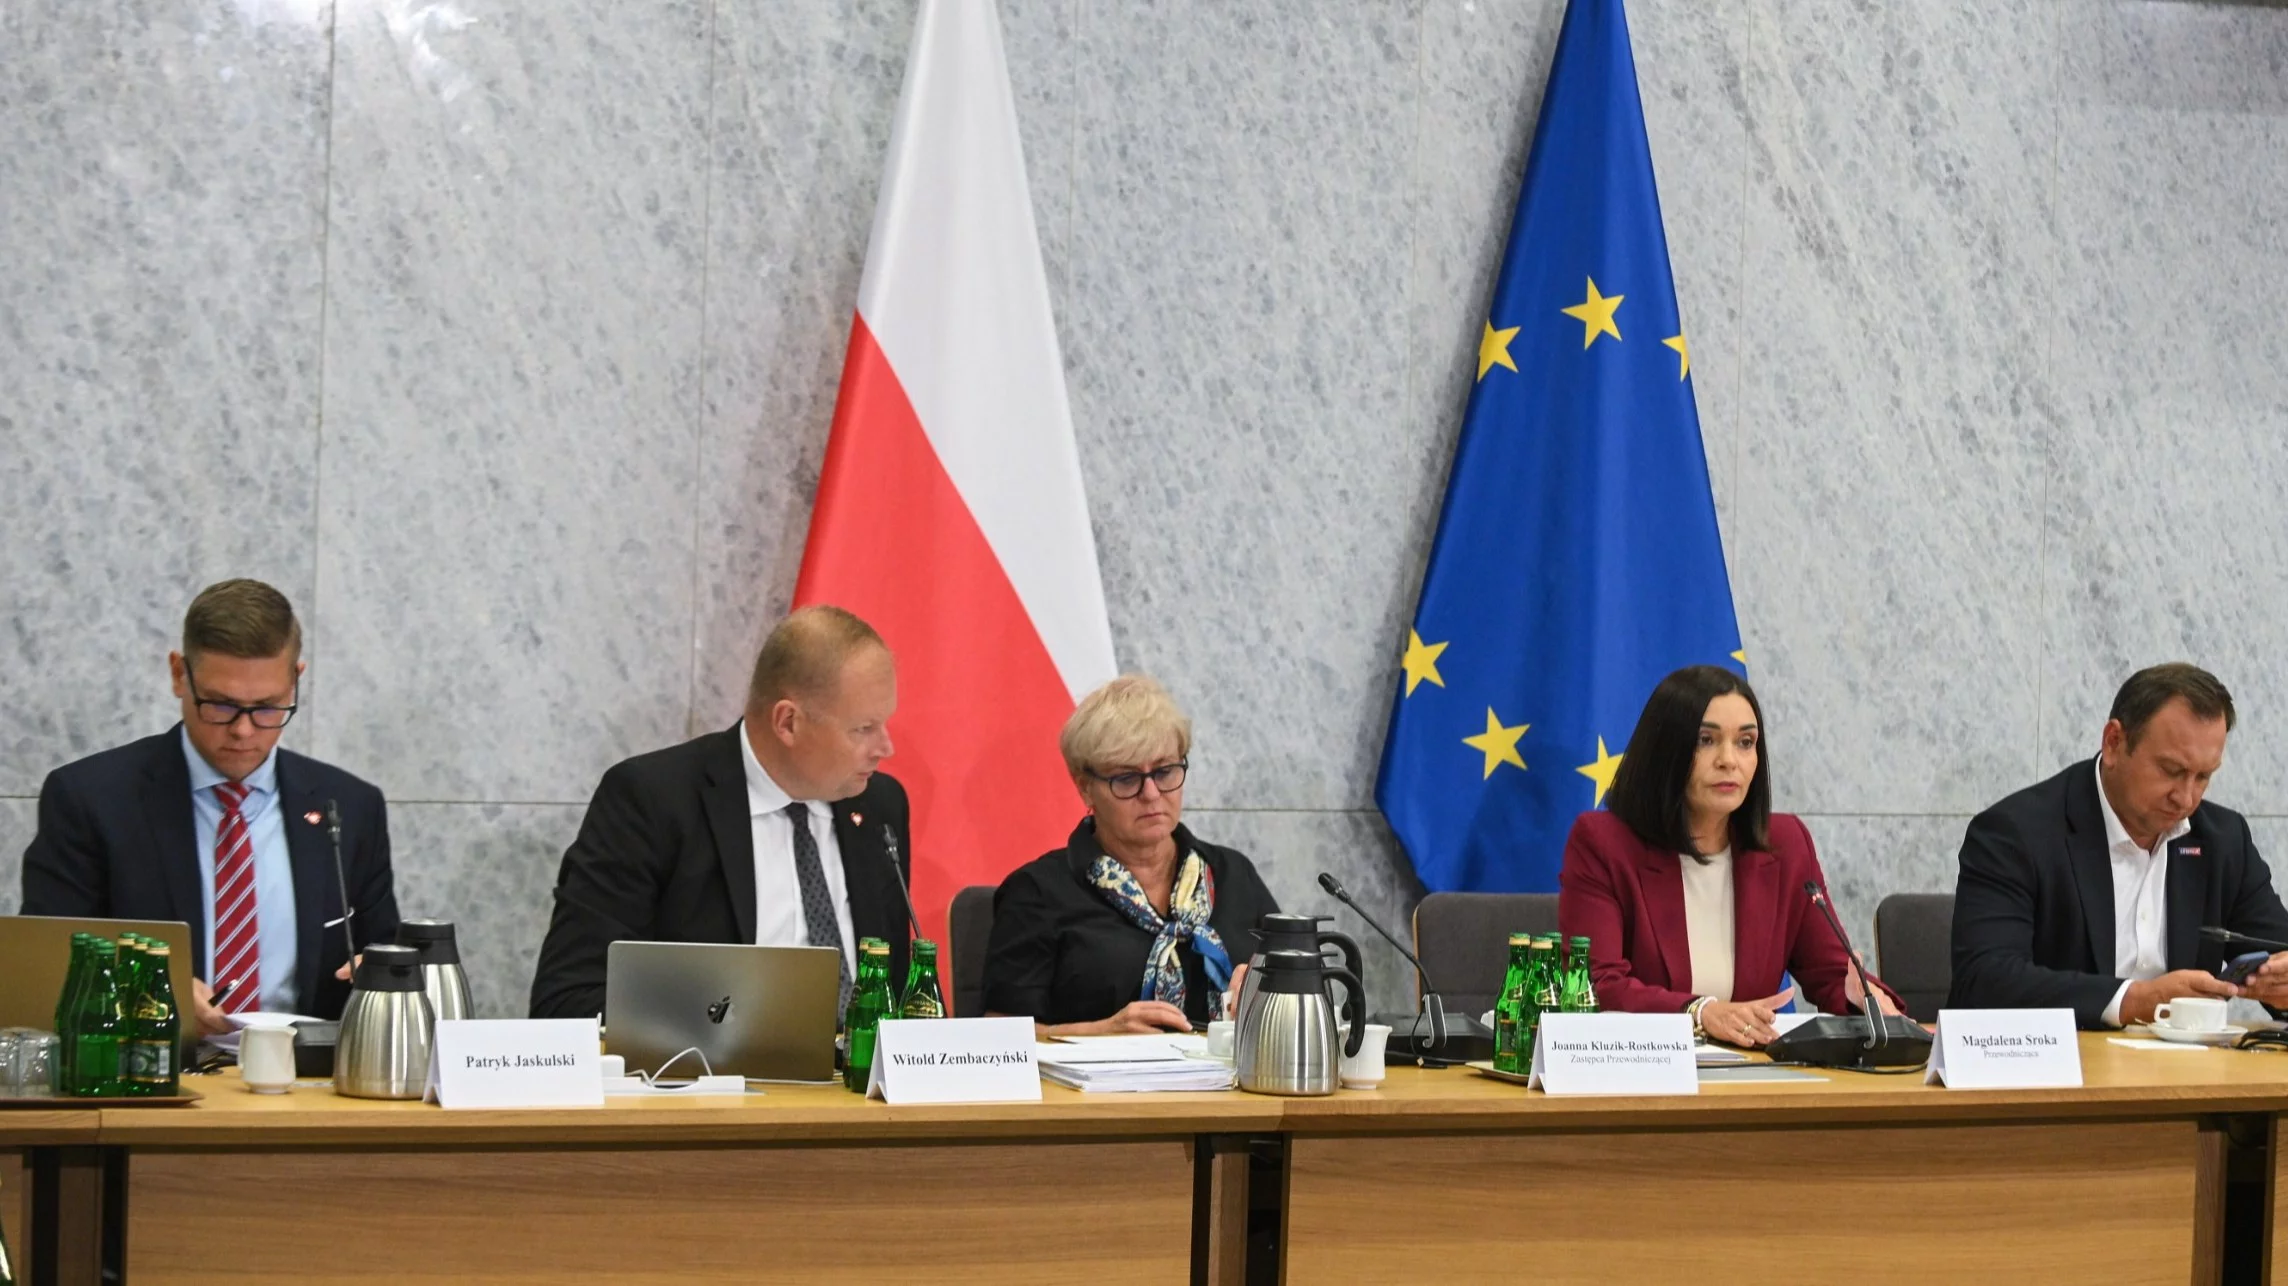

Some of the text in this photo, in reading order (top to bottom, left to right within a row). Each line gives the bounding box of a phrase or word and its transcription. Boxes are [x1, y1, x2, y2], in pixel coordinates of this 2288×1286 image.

[1551, 1040, 1688, 1051] Joanna Kluzik-Rostkowska
[1962, 1034, 2058, 1049] Magdalena Sroka
[466, 1054, 575, 1071] Patryk Jaskulski
[893, 1051, 1028, 1067] Witold Zembaczyński
[1570, 1054, 1671, 1065] Zastępca Przewodniczącej
